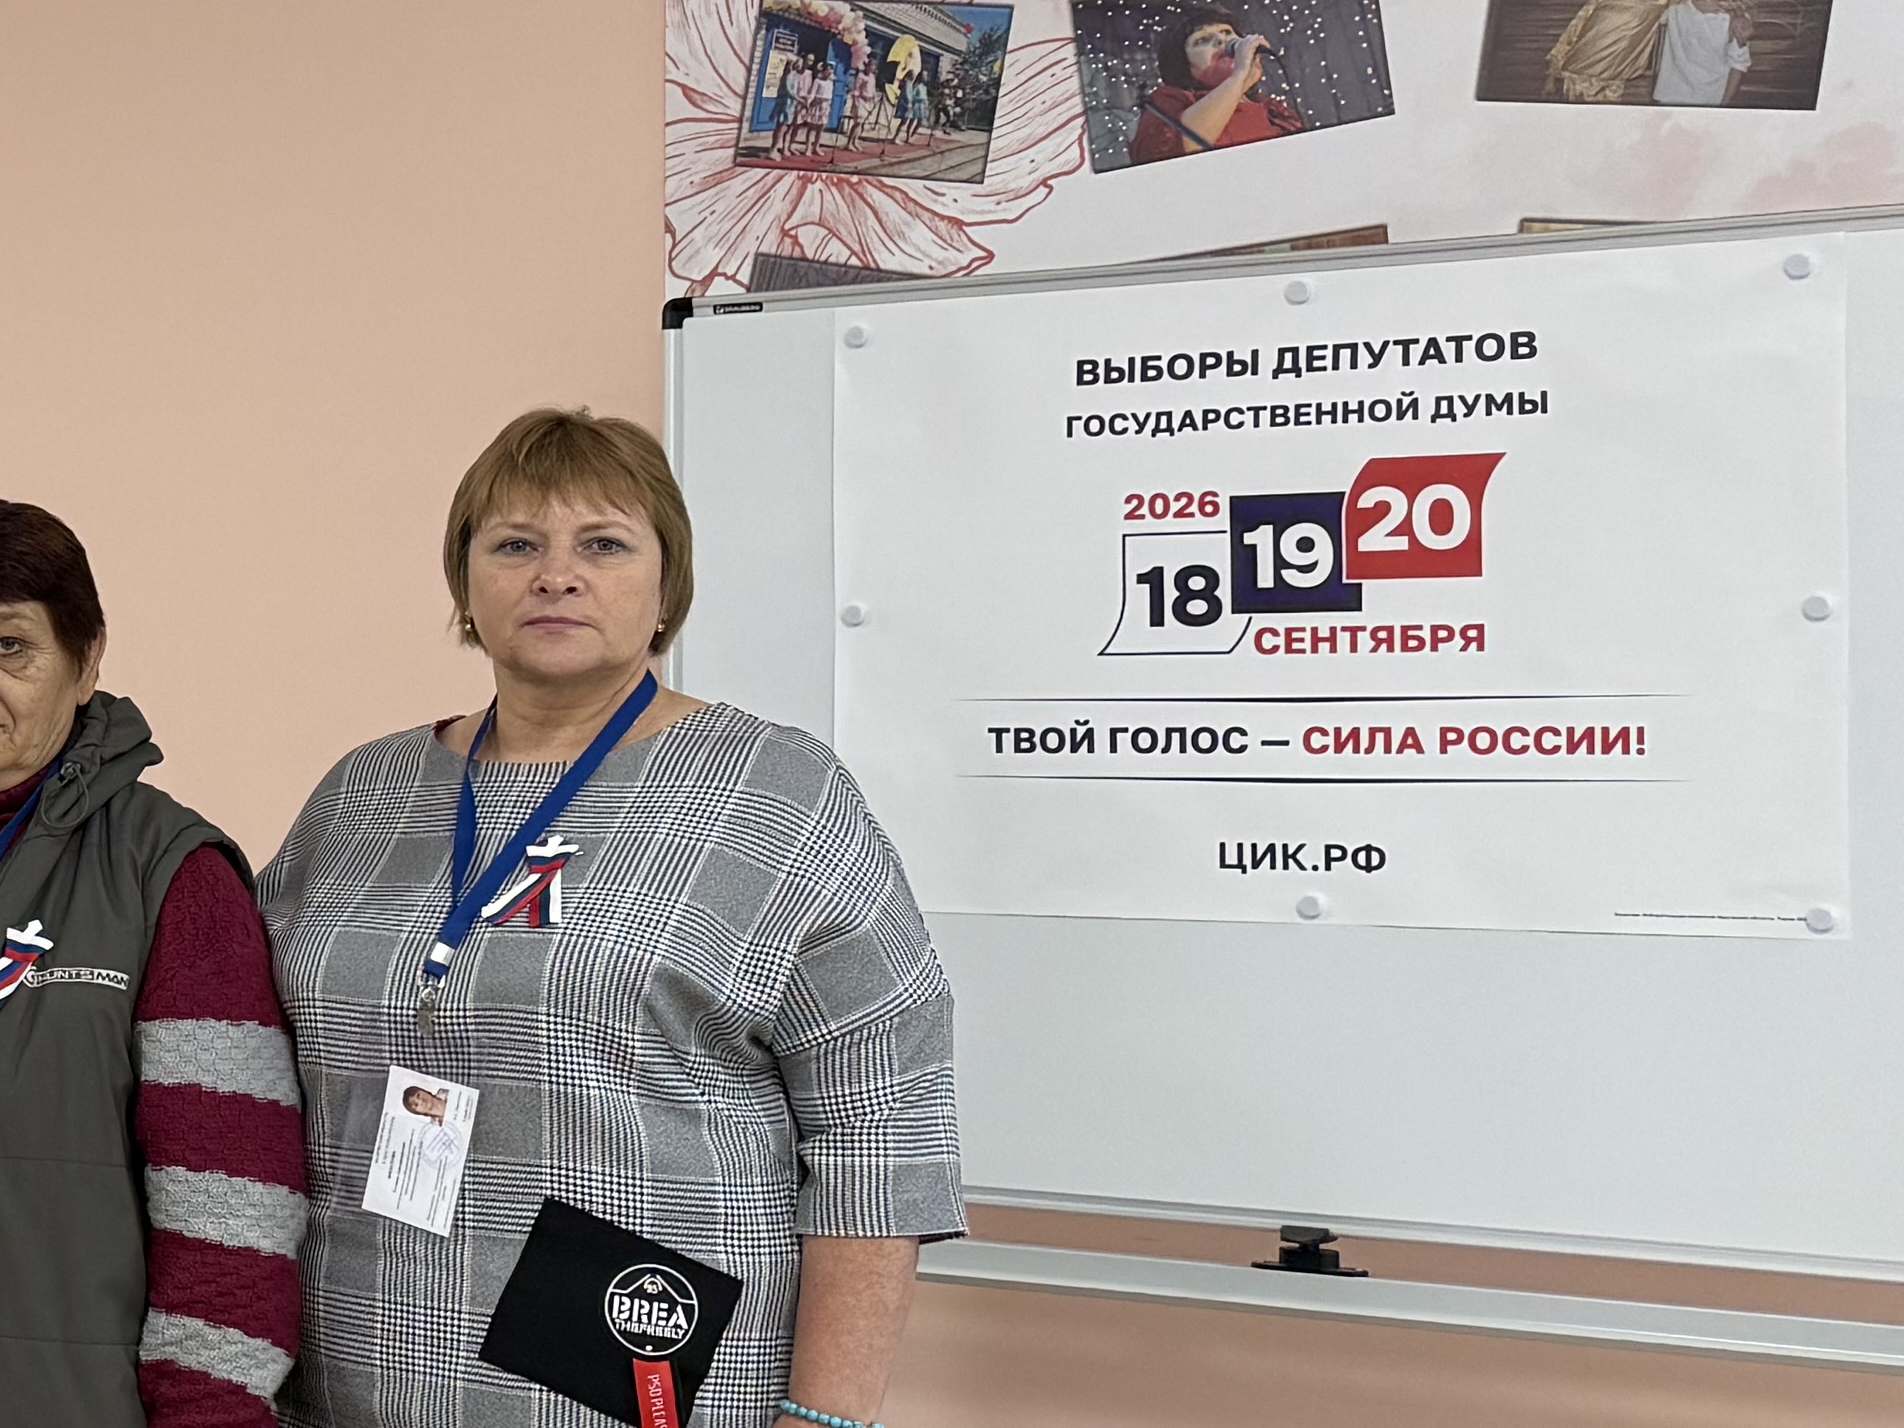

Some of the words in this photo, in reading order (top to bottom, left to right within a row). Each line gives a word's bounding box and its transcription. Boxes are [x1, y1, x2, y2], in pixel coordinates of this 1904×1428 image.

[1075, 348, 1260, 387] ВЫБОРЫ
[1271, 329, 1539, 380] ДЕПУТАТОВ
[1065, 390, 1420, 439] ГОСУДАРСТВЕННОЙ
[1429, 389, 1549, 424] ДУМЫ
[1122, 490, 1221, 521] 2026
[1135, 563, 1224, 629] 18
[1241, 521, 1335, 589] 19
[1355, 482, 1473, 552] 20
[1252, 622, 1486, 656] СЕНТЯБРЯ
[987, 719, 1094, 756] ТВОЙ
[1108, 725, 1249, 756] ГОЛОС
[1301, 725, 1425, 757] СИЛА
[1437, 725, 1647, 757] РОССИИ!
[1218, 841, 1387, 875] ЦИК.РФ
[612, 1294, 689, 1330] BREA
